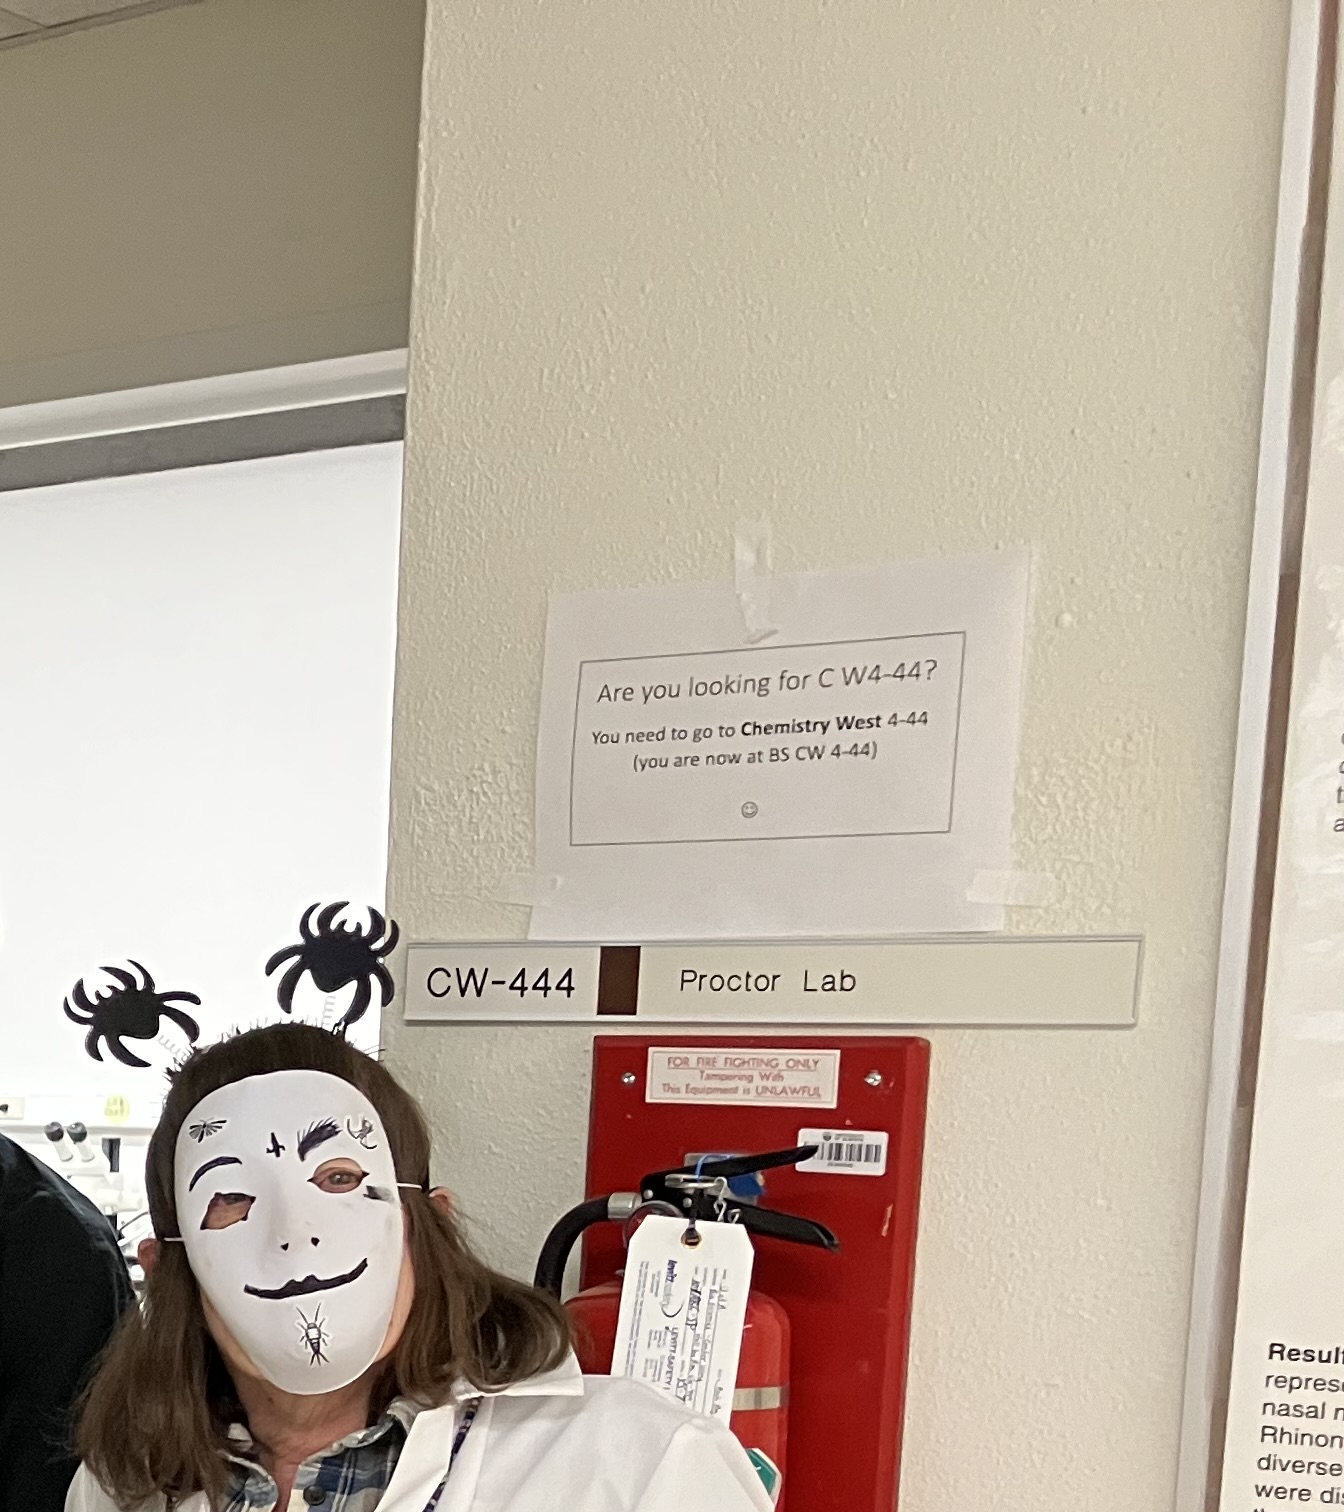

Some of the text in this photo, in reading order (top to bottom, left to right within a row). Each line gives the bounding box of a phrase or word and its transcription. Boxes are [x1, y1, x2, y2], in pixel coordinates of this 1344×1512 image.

[596, 659, 938, 705] Are you looking for C W4-44?
[592, 711, 929, 746] You need to go to Chemistry West 4-44
[632, 740, 878, 773] (you are now at BS CW 4-44)
[426, 967, 856, 999] CW-444 Proctor Lab
[667, 1056, 820, 1069] FOR FIRE FIGHTING ONLY
[699, 1070, 785, 1083] Tampering With
[662, 1083, 681, 1095] This
[685, 1083, 739, 1096] Equipment
[755, 1085, 822, 1098] UNLAWFUL
[1262, 1401, 1326, 1420] nasal
[1260, 1425, 1344, 1449] Rhinon
[1257, 1453, 1343, 1477] diverse
[1254, 1484, 1312, 1502] were
